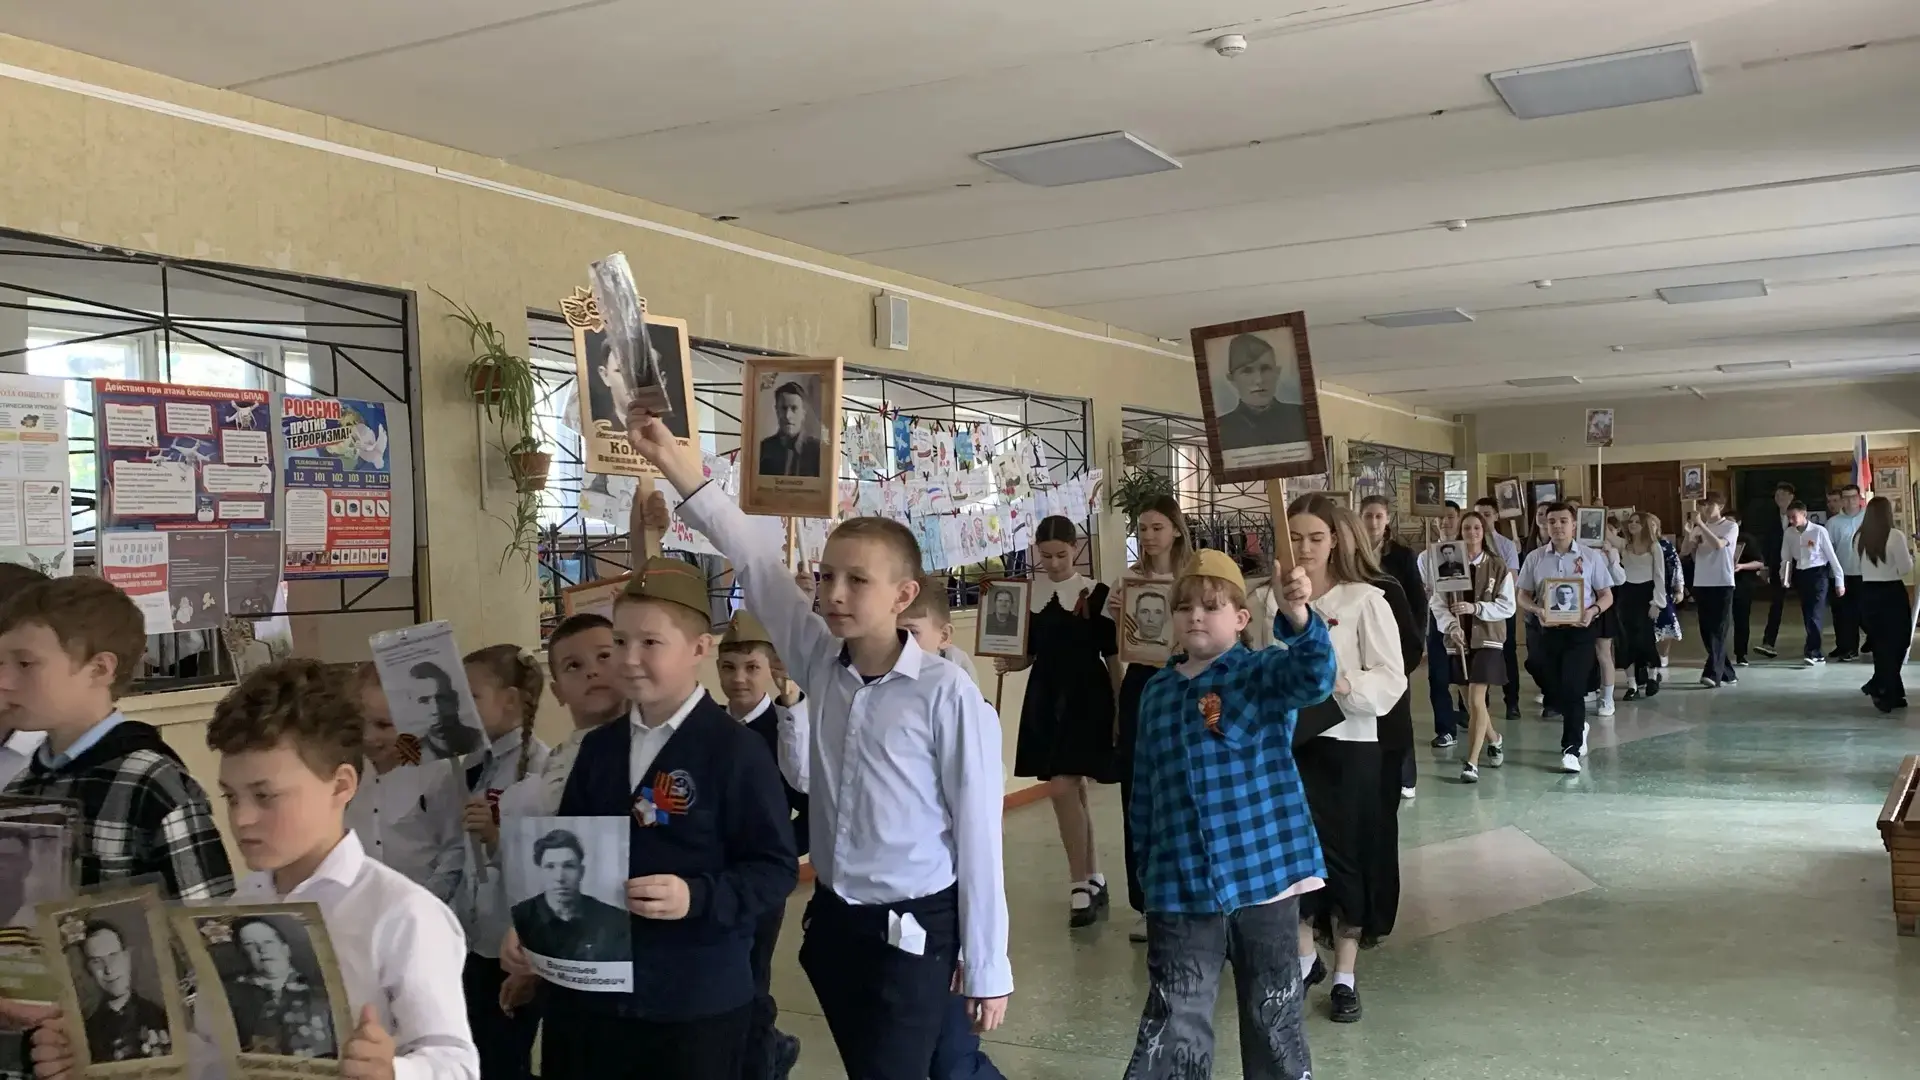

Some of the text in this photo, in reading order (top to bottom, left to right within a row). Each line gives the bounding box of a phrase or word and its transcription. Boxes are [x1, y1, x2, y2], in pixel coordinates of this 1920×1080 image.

[105, 382, 265, 402] Действия при атаке беспилотника (БПЛА)
[284, 398, 341, 419] РОССИЯ
[290, 418, 327, 435] ПРОТИВ
[286, 427, 351, 450] ТЕРРОРИЗМА!
[293, 471, 389, 484] 112 101 102 103 121 123
[109, 541, 164, 553] НАРОДНЫЙ
[120, 554, 155, 564] ФРОНТ
[557, 971, 626, 985] Михайлович
